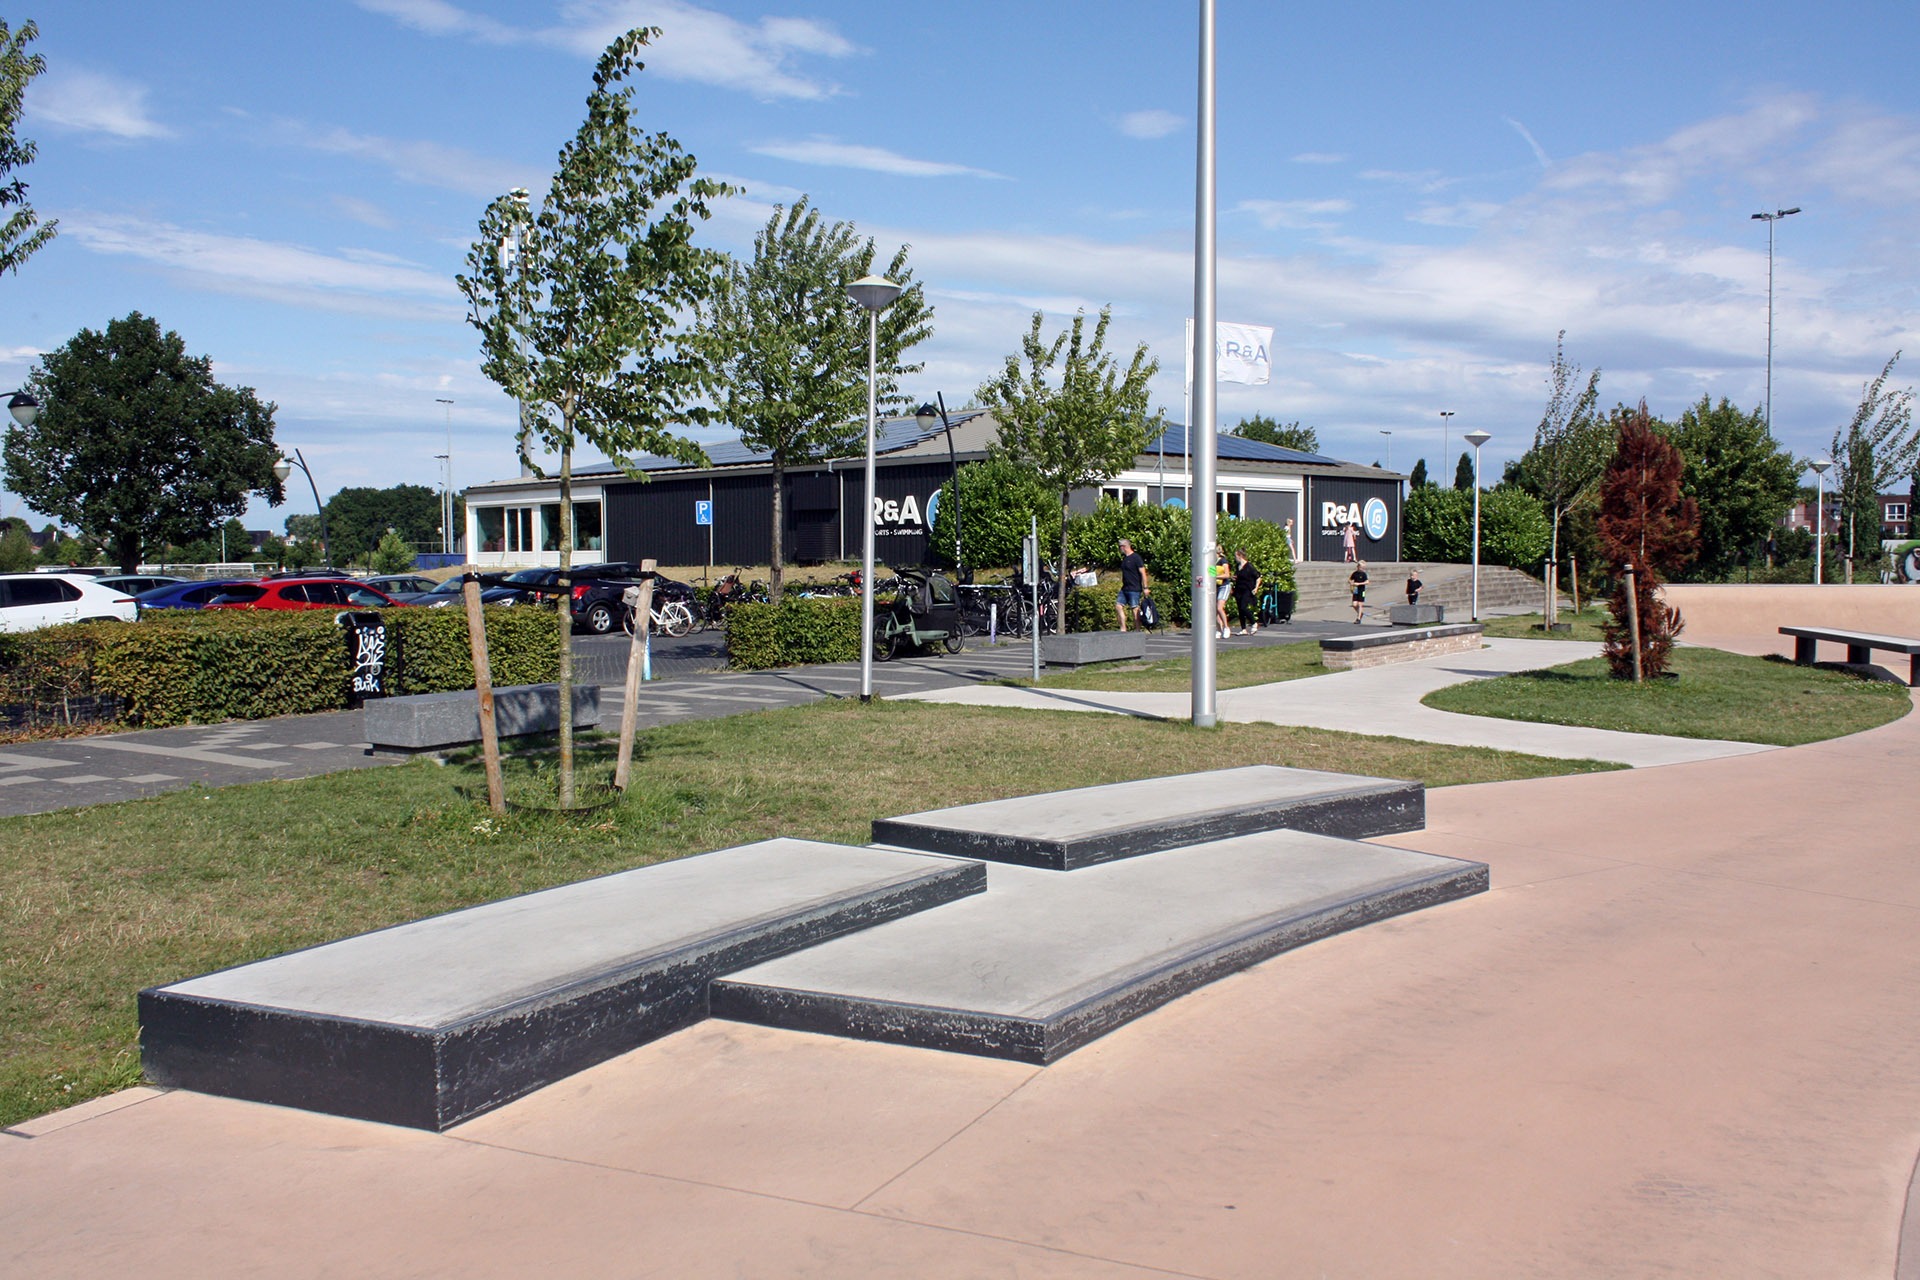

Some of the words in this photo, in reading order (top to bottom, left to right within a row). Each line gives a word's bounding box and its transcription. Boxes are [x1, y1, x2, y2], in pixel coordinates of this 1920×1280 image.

[1226, 341, 1268, 362] R&A
[699, 503, 708, 514] P
[1322, 501, 1363, 527] R&A
